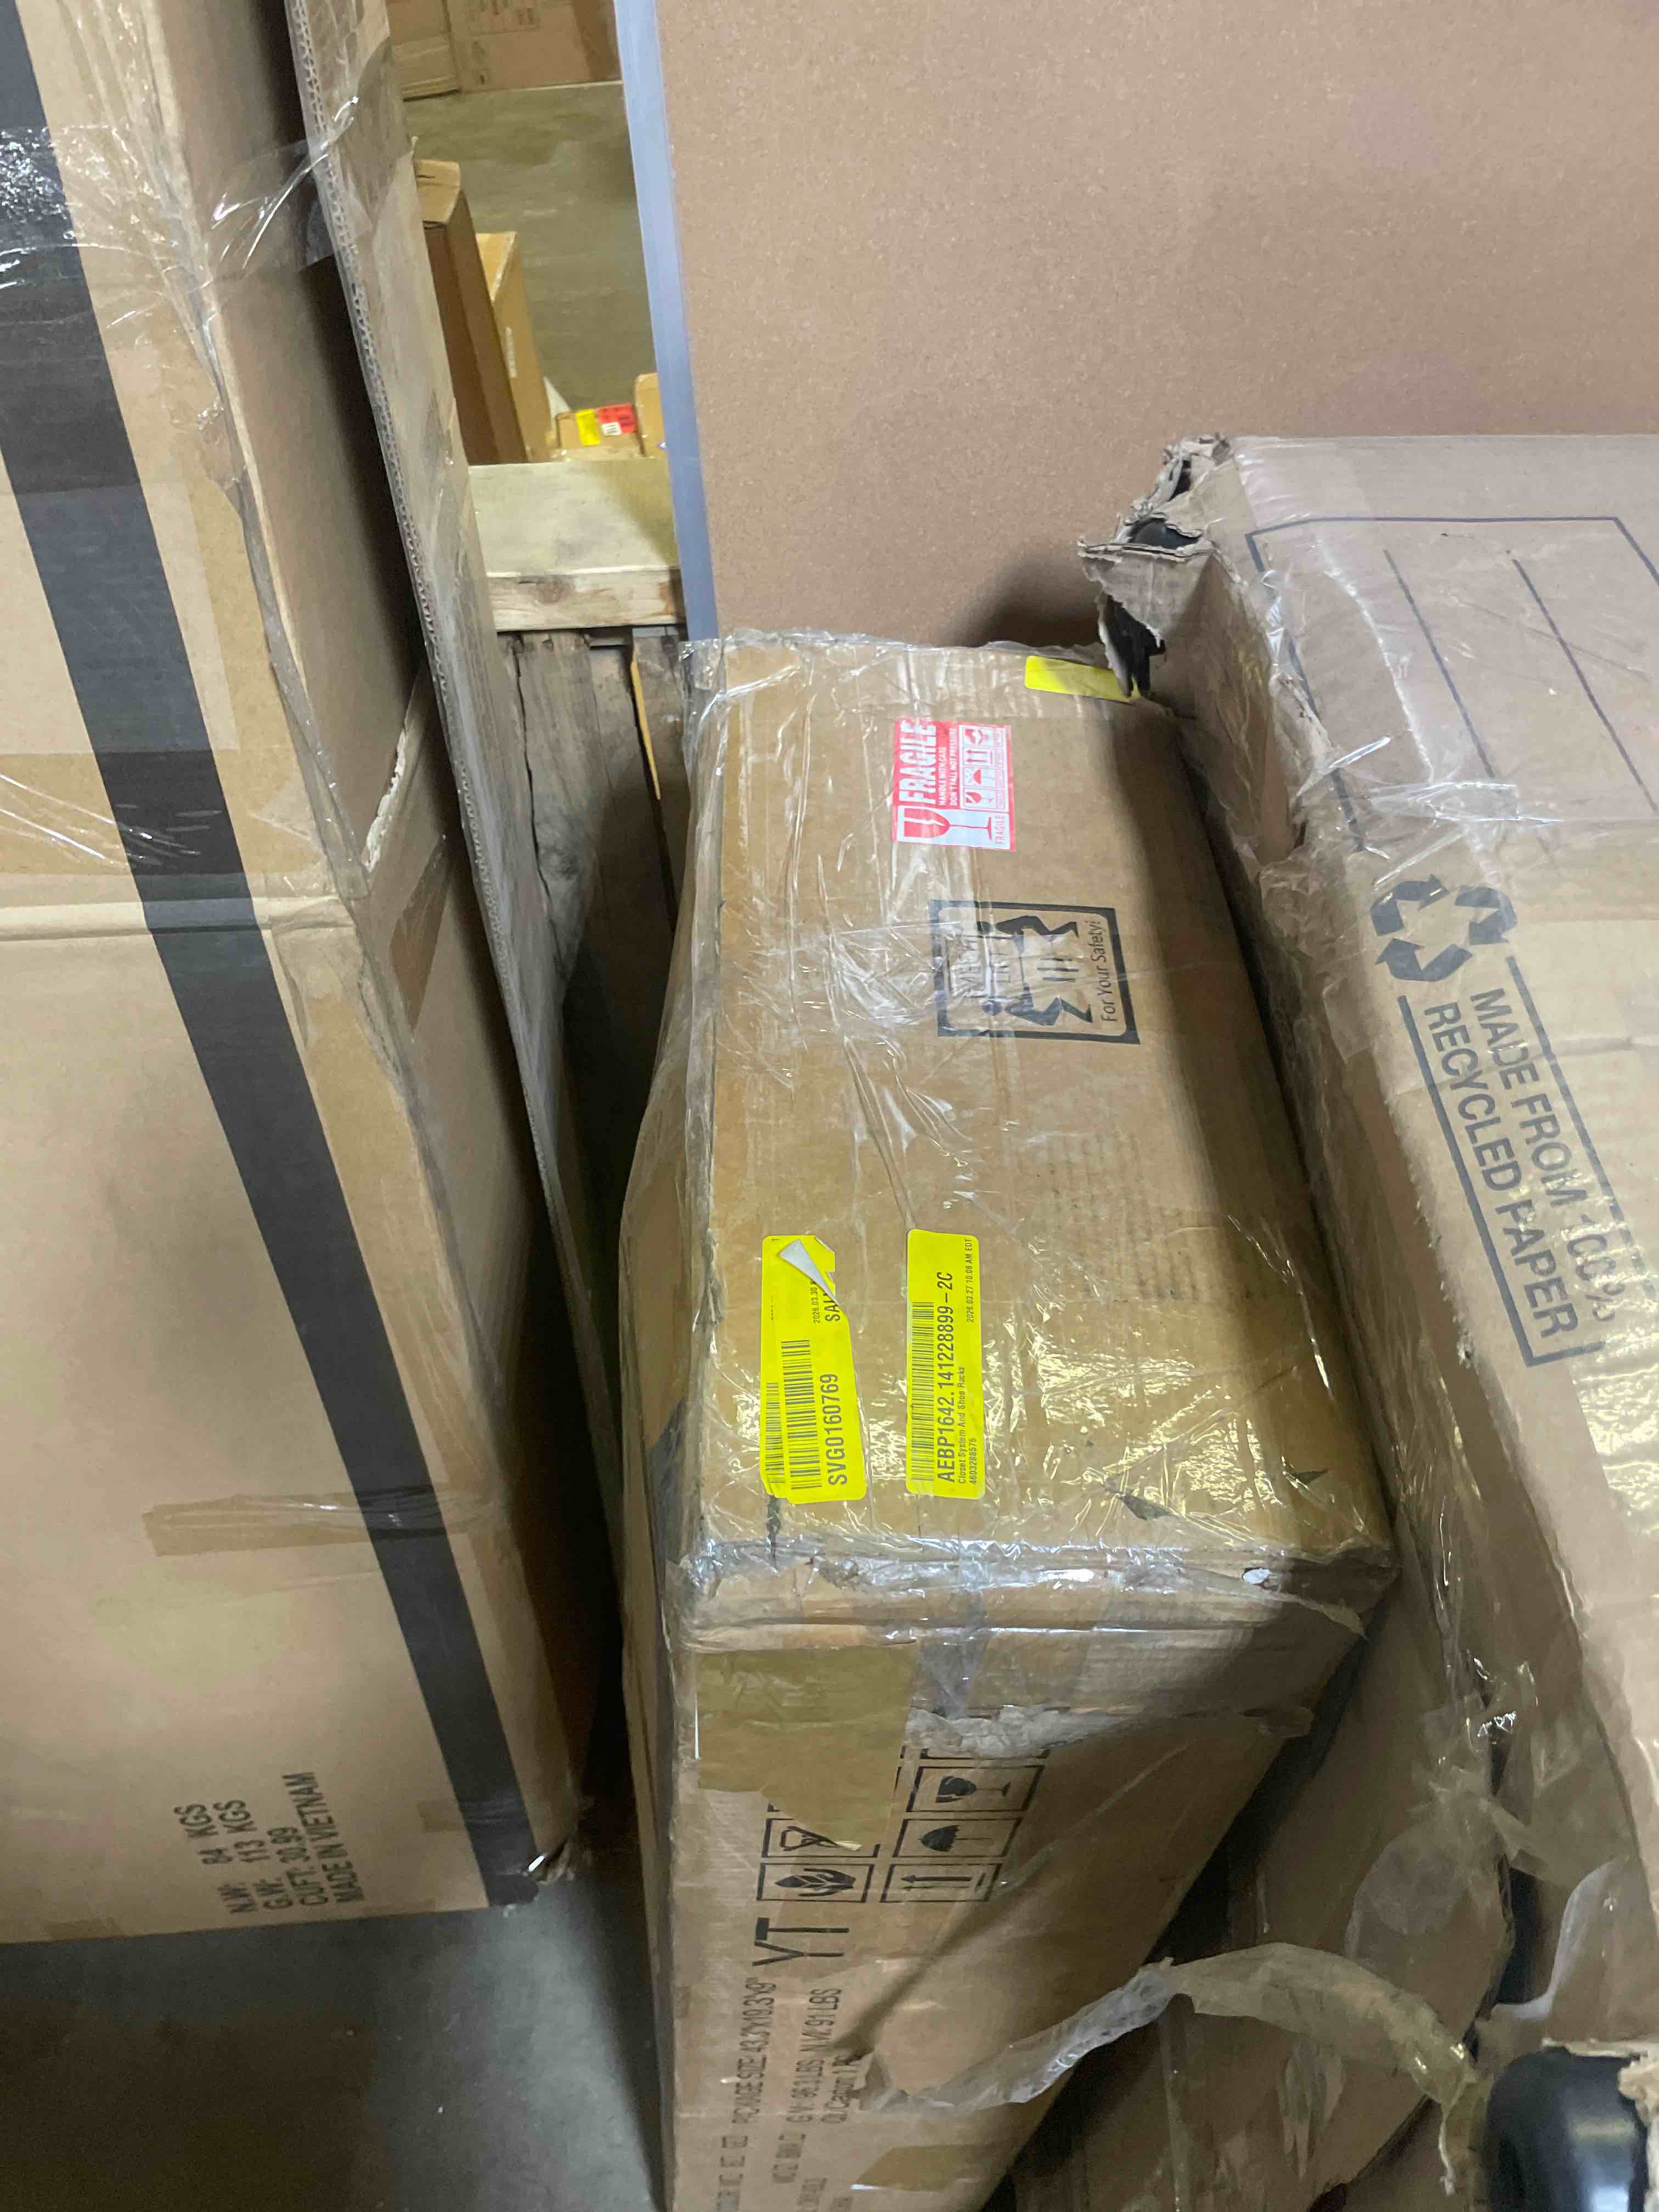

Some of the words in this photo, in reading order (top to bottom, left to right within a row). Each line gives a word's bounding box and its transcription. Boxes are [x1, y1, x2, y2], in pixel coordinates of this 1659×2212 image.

[899, 719, 936, 804] FRAGILE
[995, 815, 1005, 844] FRAGILE
[1085, 921, 1106, 963] Safety!
[1097, 966, 1112, 996] Your
[1101, 1000, 1118, 1021] For
[1470, 988, 1539, 1090] MADE
[1511, 1094, 1588, 1207] FROM
[1425, 1001, 1522, 1192] RECYCLED
[1496, 1198, 1579, 1338] PAPER
[964, 1239, 973, 1251] EDT
[957, 1366, 966, 1388] Racks
[957, 1412, 966, 1427] And
[958, 1430, 968, 1457] System
[174, 1803, 219, 1838] KGS
[213, 1799, 257, 1835] KGS
[282, 1772, 339, 1842] VIETNAM
[313, 1843, 349, 1860] IN
[321, 1860, 364, 1903] MADE
[807, 1989, 842, 2010] LBS
